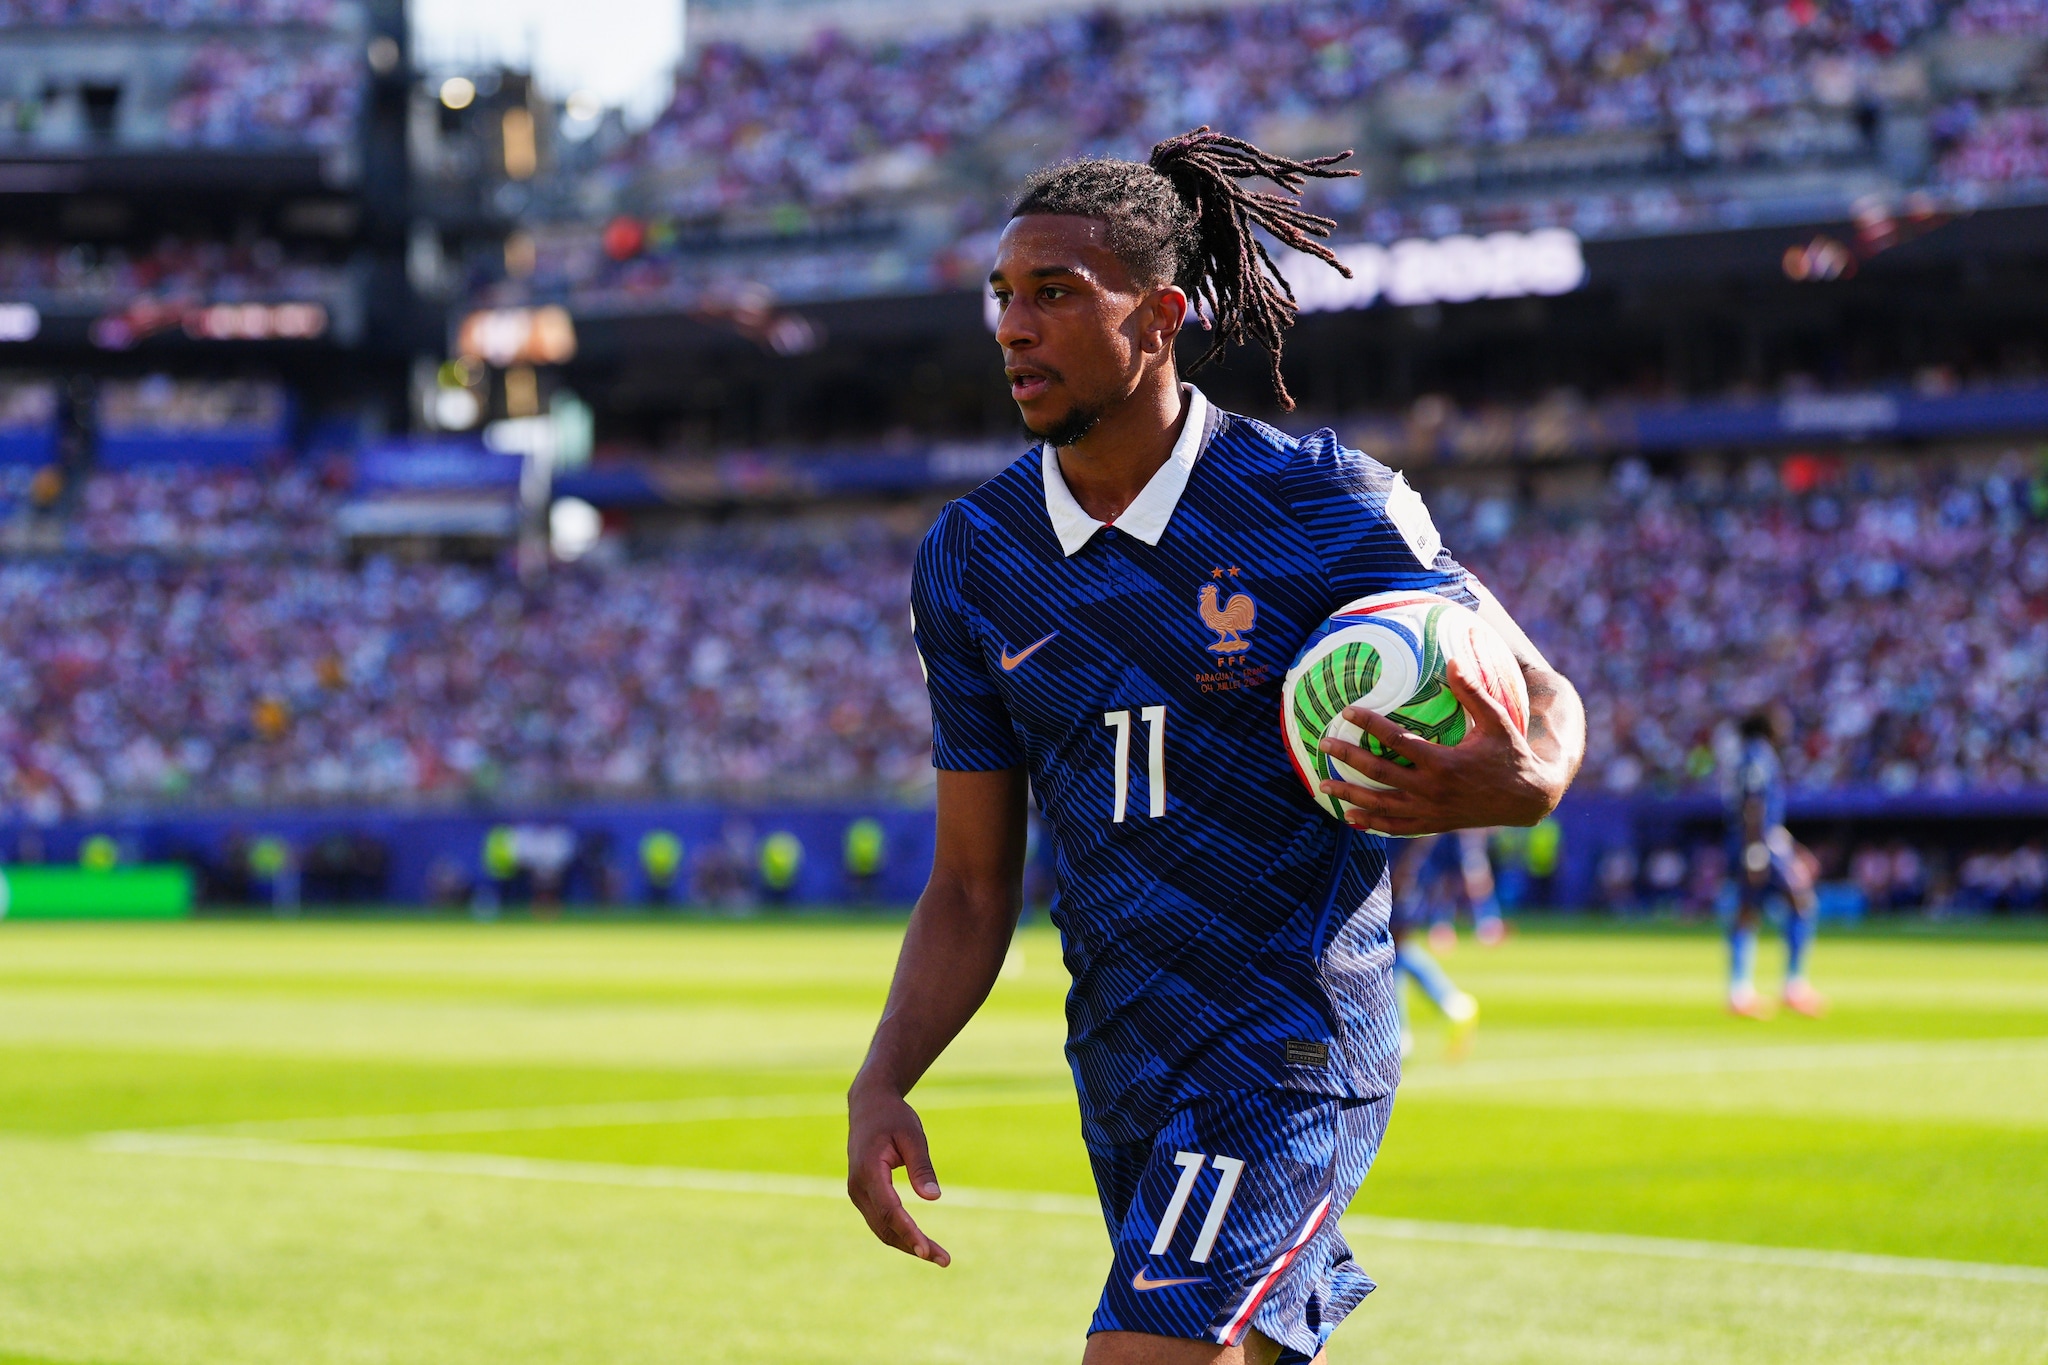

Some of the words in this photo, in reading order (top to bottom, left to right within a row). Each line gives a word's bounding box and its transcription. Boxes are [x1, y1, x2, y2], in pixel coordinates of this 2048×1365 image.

[1217, 656, 1246, 667] FFF
[1195, 672, 1234, 682] PARAGUAY
[1243, 664, 1269, 676] FRANCE
[1201, 684, 1213, 693] 04
[1216, 680, 1241, 691] JUILLET
[1243, 677, 1265, 687] 2026
[1104, 705, 1167, 823] 11
[1149, 1151, 1246, 1264] 11
